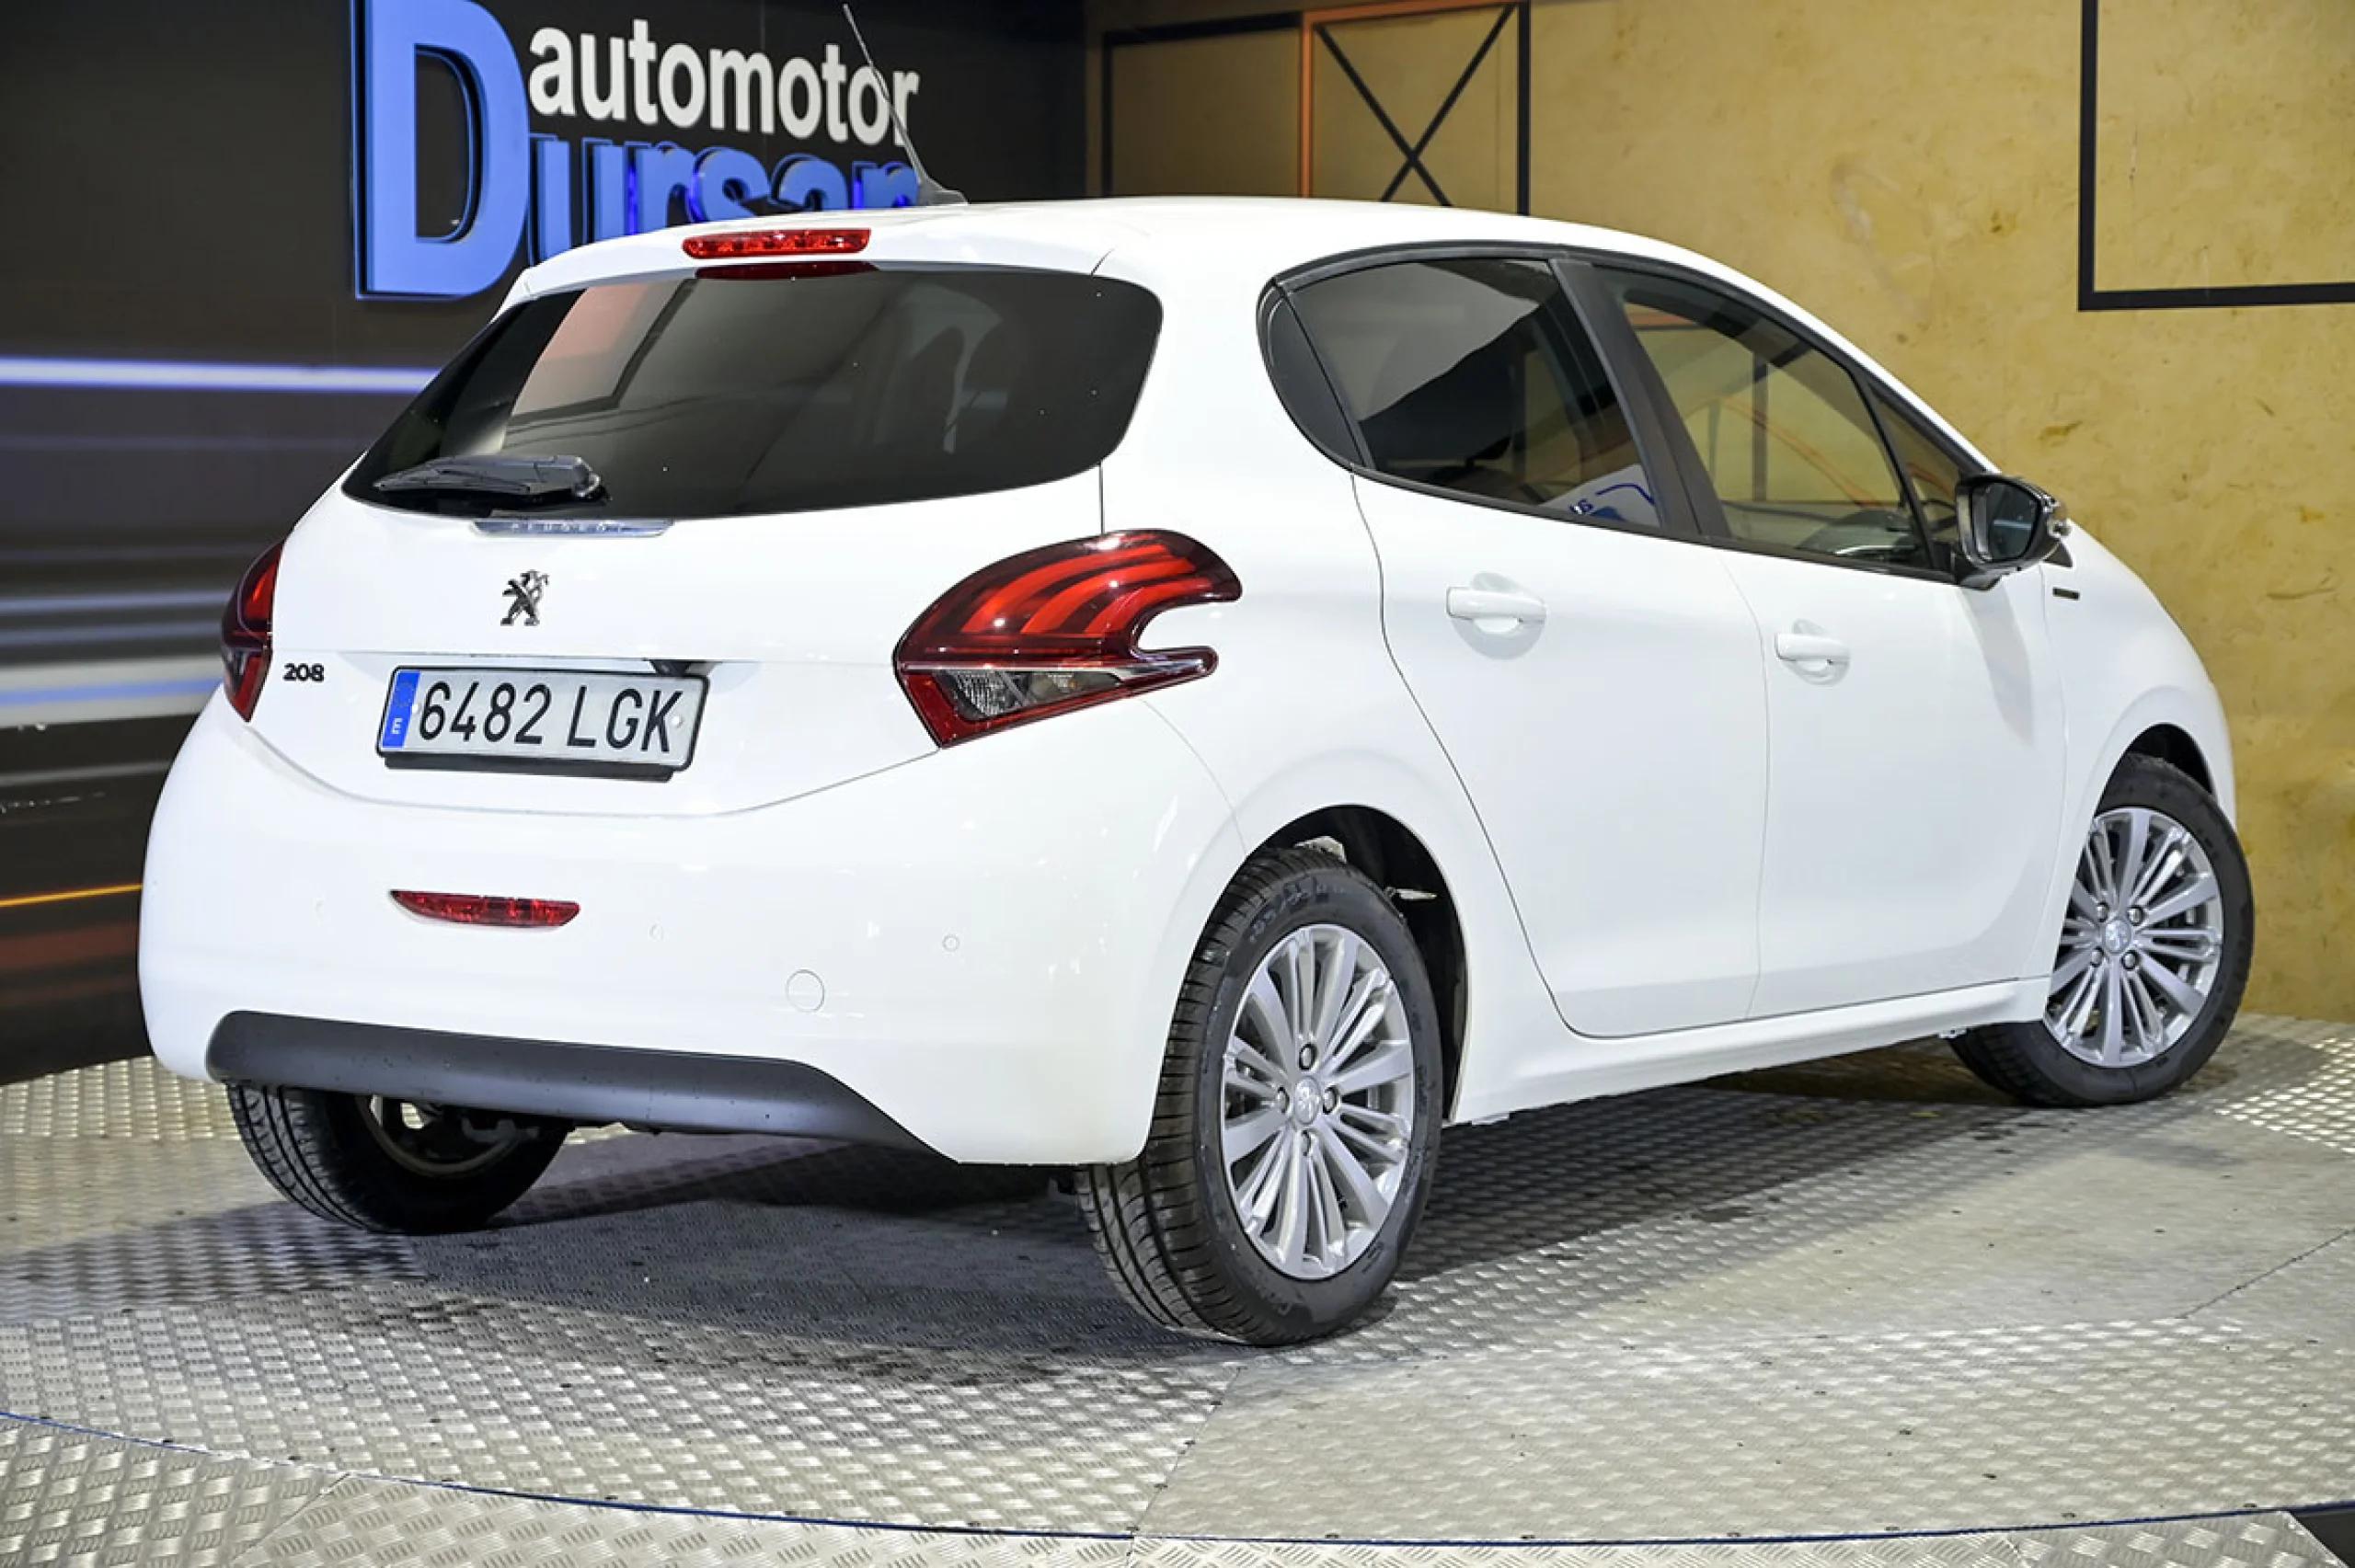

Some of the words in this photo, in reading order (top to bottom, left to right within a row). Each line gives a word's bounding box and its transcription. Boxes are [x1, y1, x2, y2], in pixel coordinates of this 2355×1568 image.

[529, 18, 919, 147] automotor
[282, 662, 325, 682] 208
[391, 717, 403, 735] E
[419, 681, 552, 745] 6482
[567, 684, 684, 752] LGK
